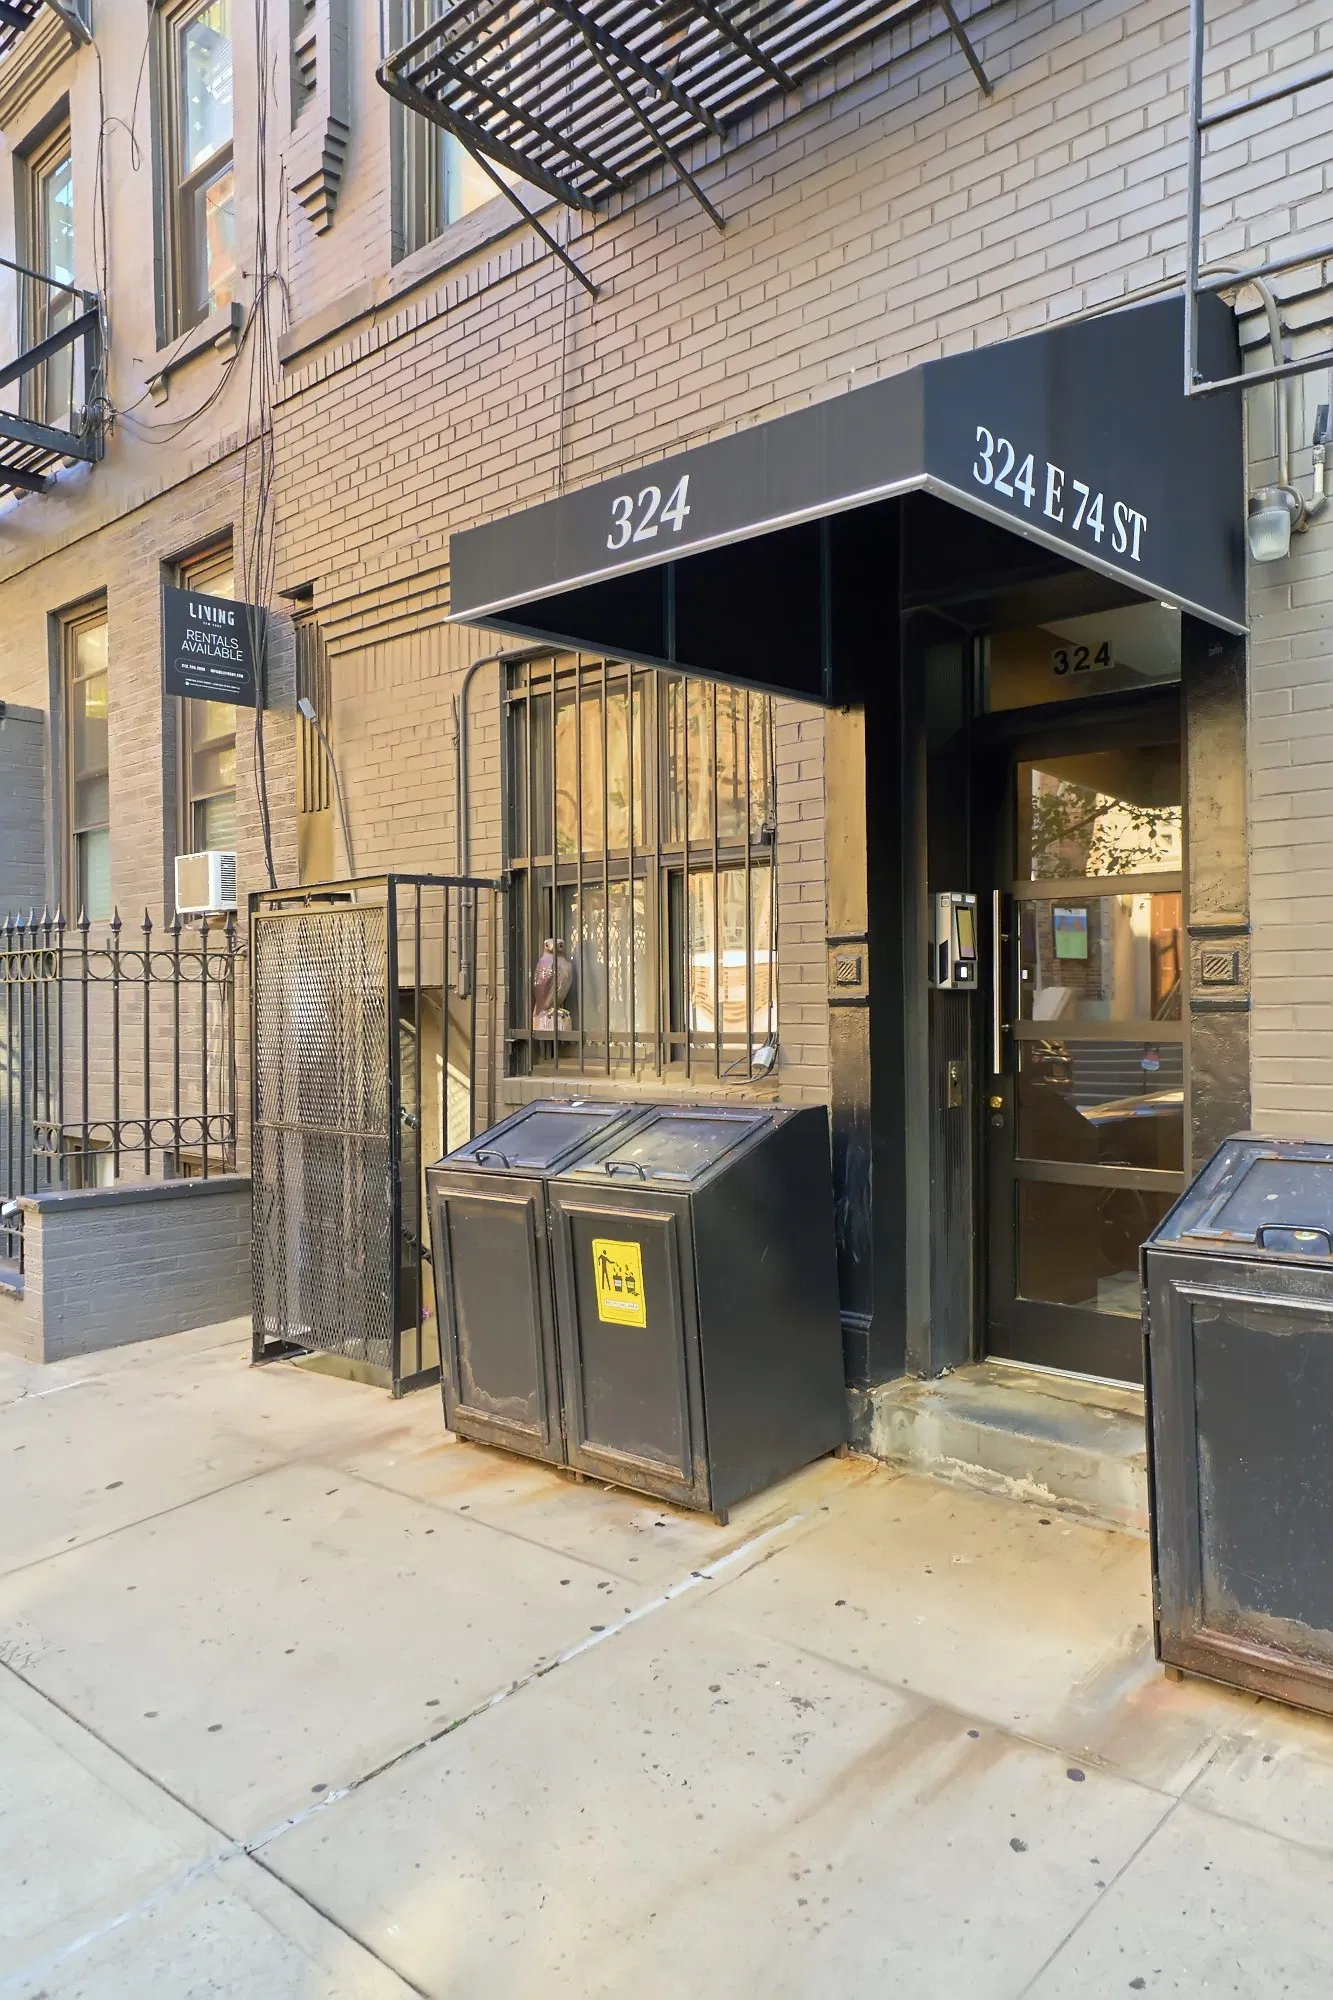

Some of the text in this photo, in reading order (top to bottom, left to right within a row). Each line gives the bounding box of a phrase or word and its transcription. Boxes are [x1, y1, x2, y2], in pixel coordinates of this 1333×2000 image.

[972, 426, 1148, 562] 324 E 74 ST
[606, 474, 691, 550] 324
[189, 602, 235, 626] LIVING
[181, 640, 244, 662] AVAILABLE
[186, 629, 239, 650] RENTALS
[1053, 642, 1111, 675] 324
